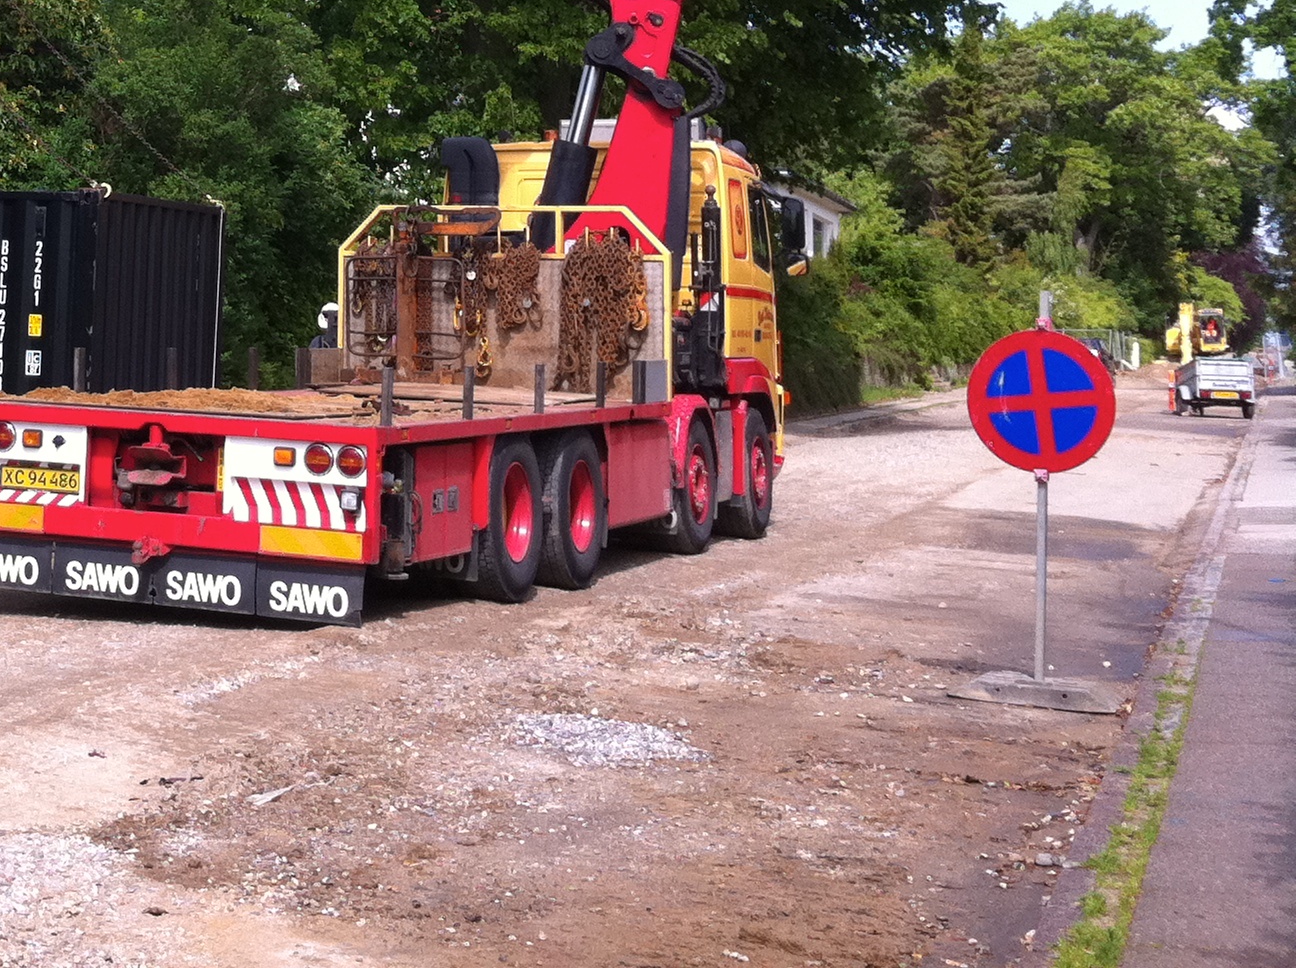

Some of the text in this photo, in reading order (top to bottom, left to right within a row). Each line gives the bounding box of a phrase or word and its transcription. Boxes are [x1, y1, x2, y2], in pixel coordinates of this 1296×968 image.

[33, 240, 44, 307] 22G1
[4, 469, 77, 489] XC 94 486
[65, 560, 140, 596] SAWO
[166, 570, 242, 607] SAWO
[269, 581, 350, 618] SAWO
